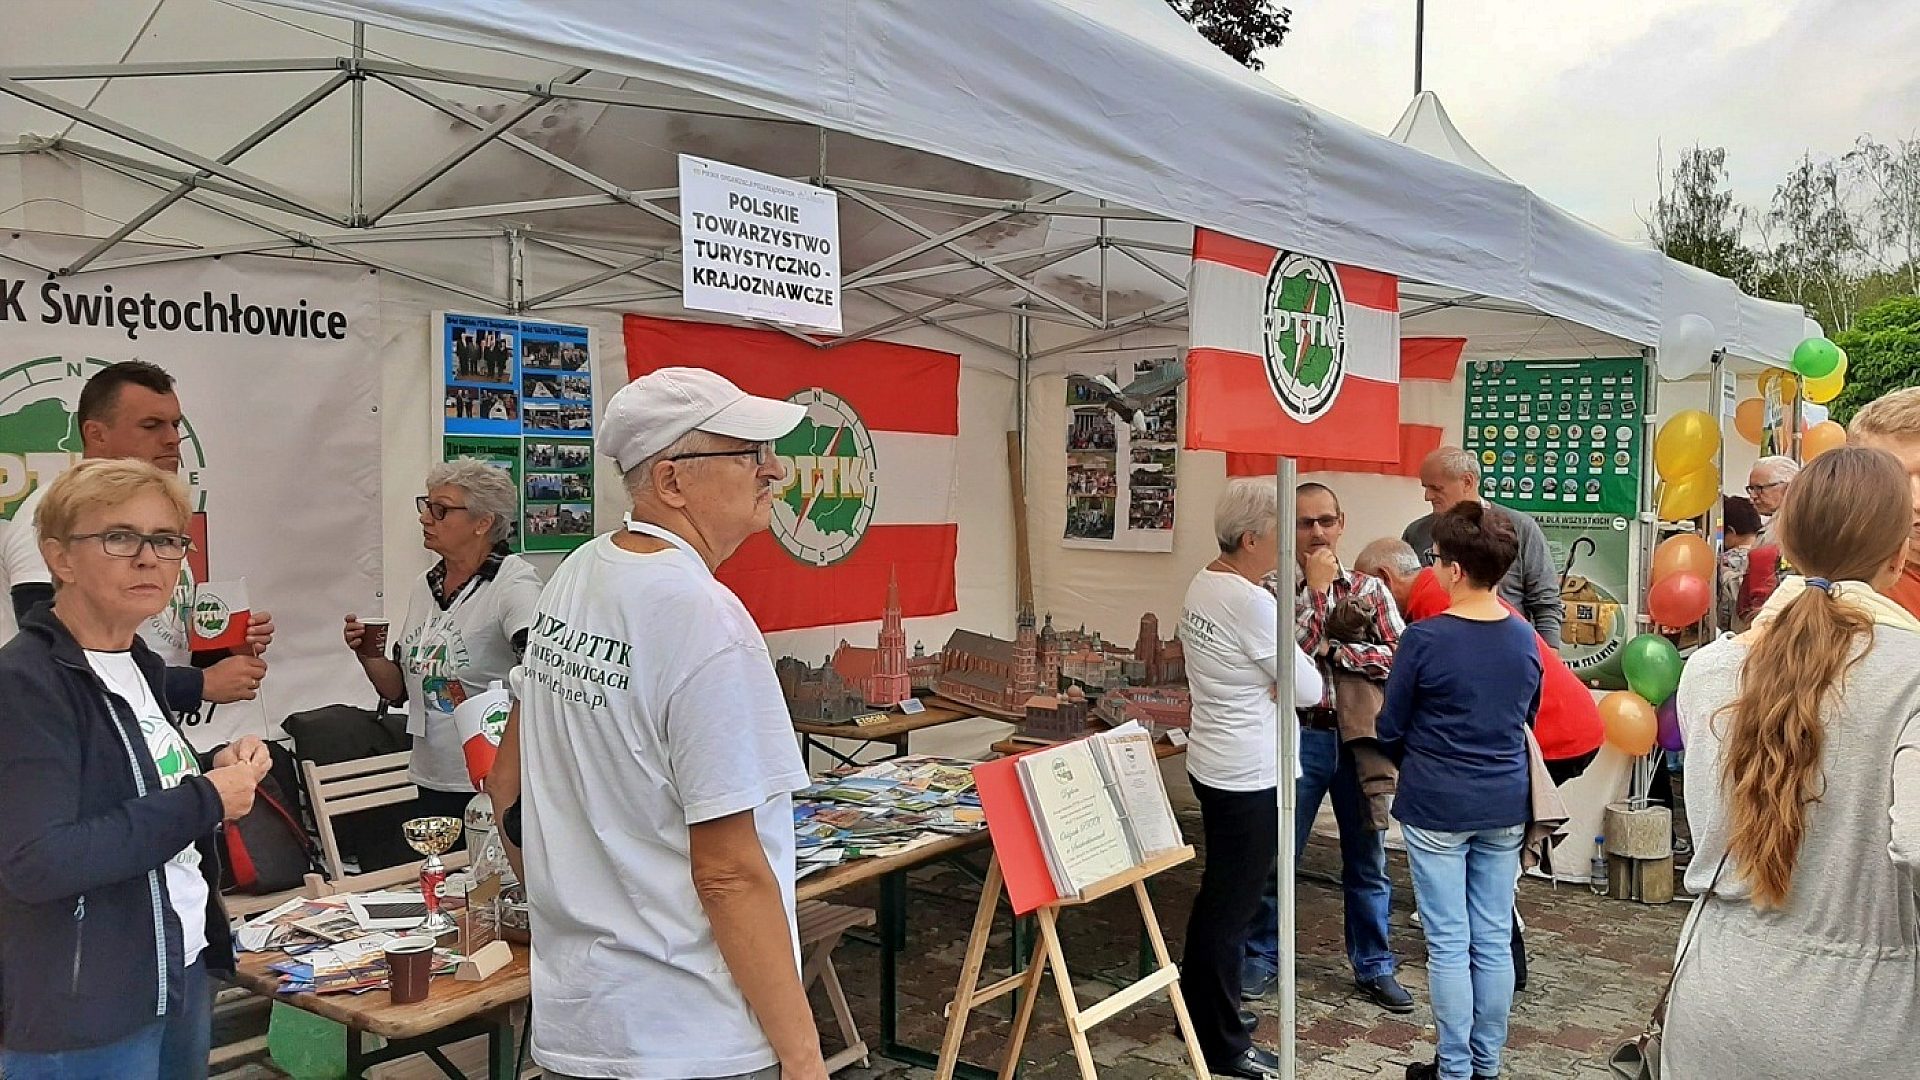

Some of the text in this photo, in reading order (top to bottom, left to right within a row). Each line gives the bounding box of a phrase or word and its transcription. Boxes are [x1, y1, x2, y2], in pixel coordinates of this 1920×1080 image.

[728, 191, 799, 224] POLSKIE
[692, 212, 831, 255] TOWARZYSTWO
[692, 267, 834, 306] KRAJOZNAWCZE
[41, 275, 348, 340] Świętochłowice
[1274, 309, 1335, 348] PTTK
[66, 362, 82, 377] N
[814, 391, 821, 403] N
[188, 471, 200, 485] E
[868, 471, 874, 483] E
[819, 551, 825, 562] S
[572, 632, 634, 668] PTTK
